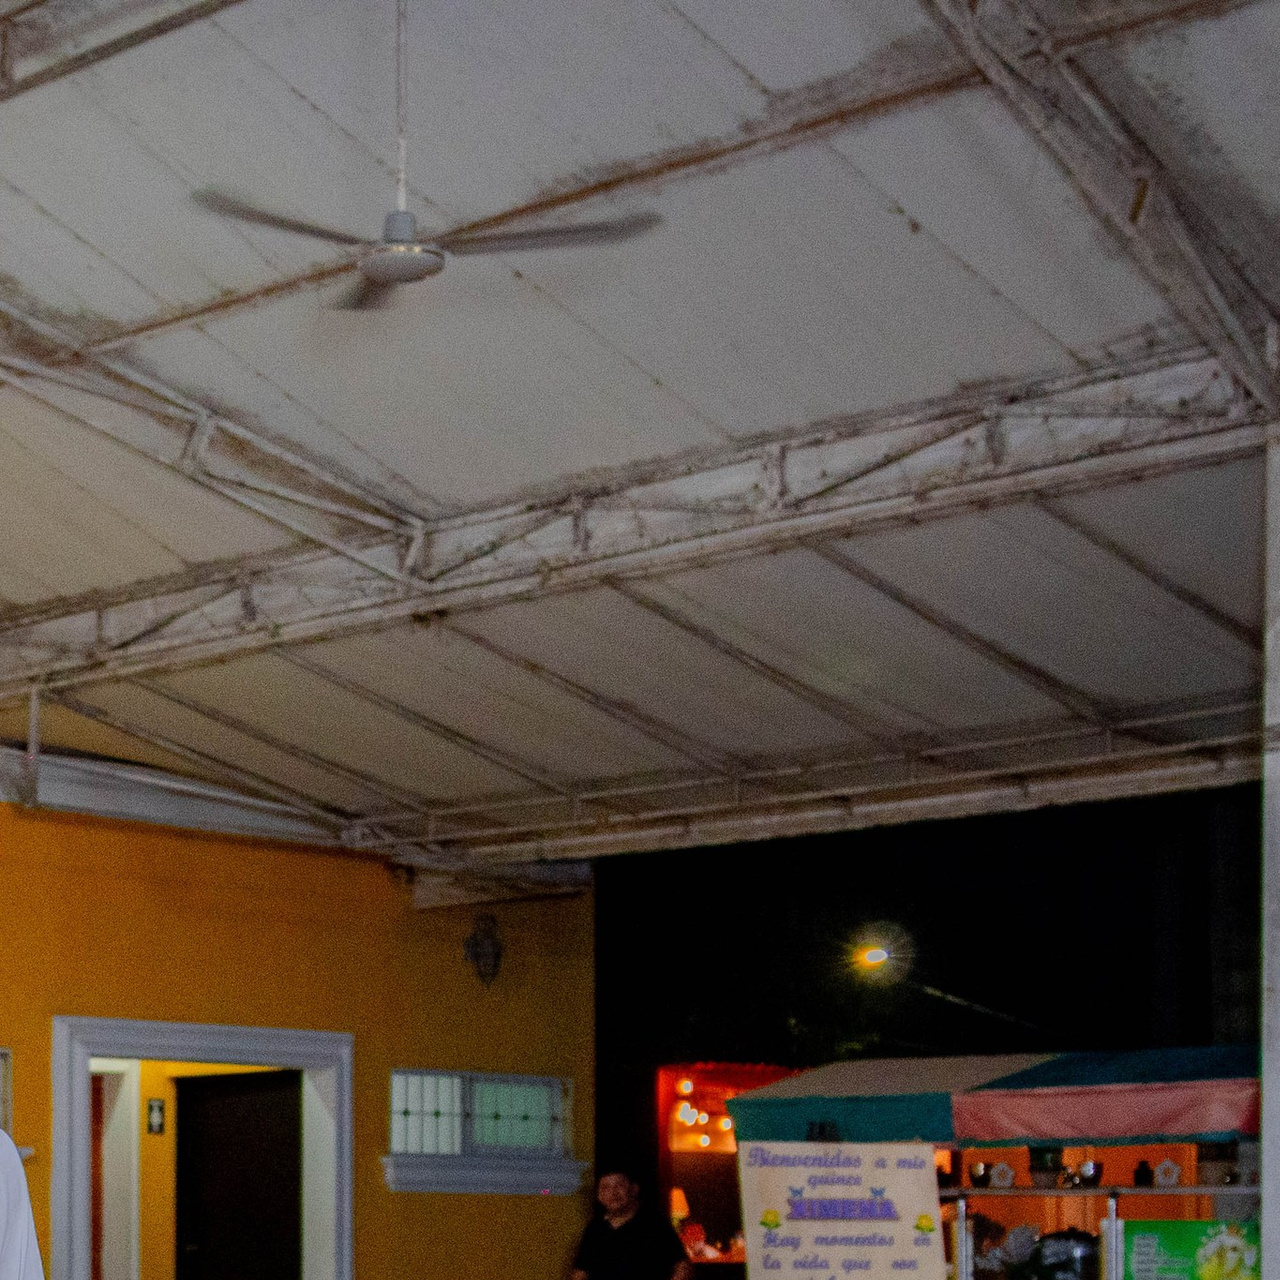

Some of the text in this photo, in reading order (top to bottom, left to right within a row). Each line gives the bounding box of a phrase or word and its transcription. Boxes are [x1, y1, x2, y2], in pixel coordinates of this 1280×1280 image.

[748, 1147, 926, 1169] Bienvenidos a mis
[786, 1198, 900, 1221] XIMENA
[763, 1230, 931, 1249] Hay momentos en
[793, 1255, 830, 1270] vida
[842, 1259, 870, 1273] que
[892, 1259, 918, 1270] son
